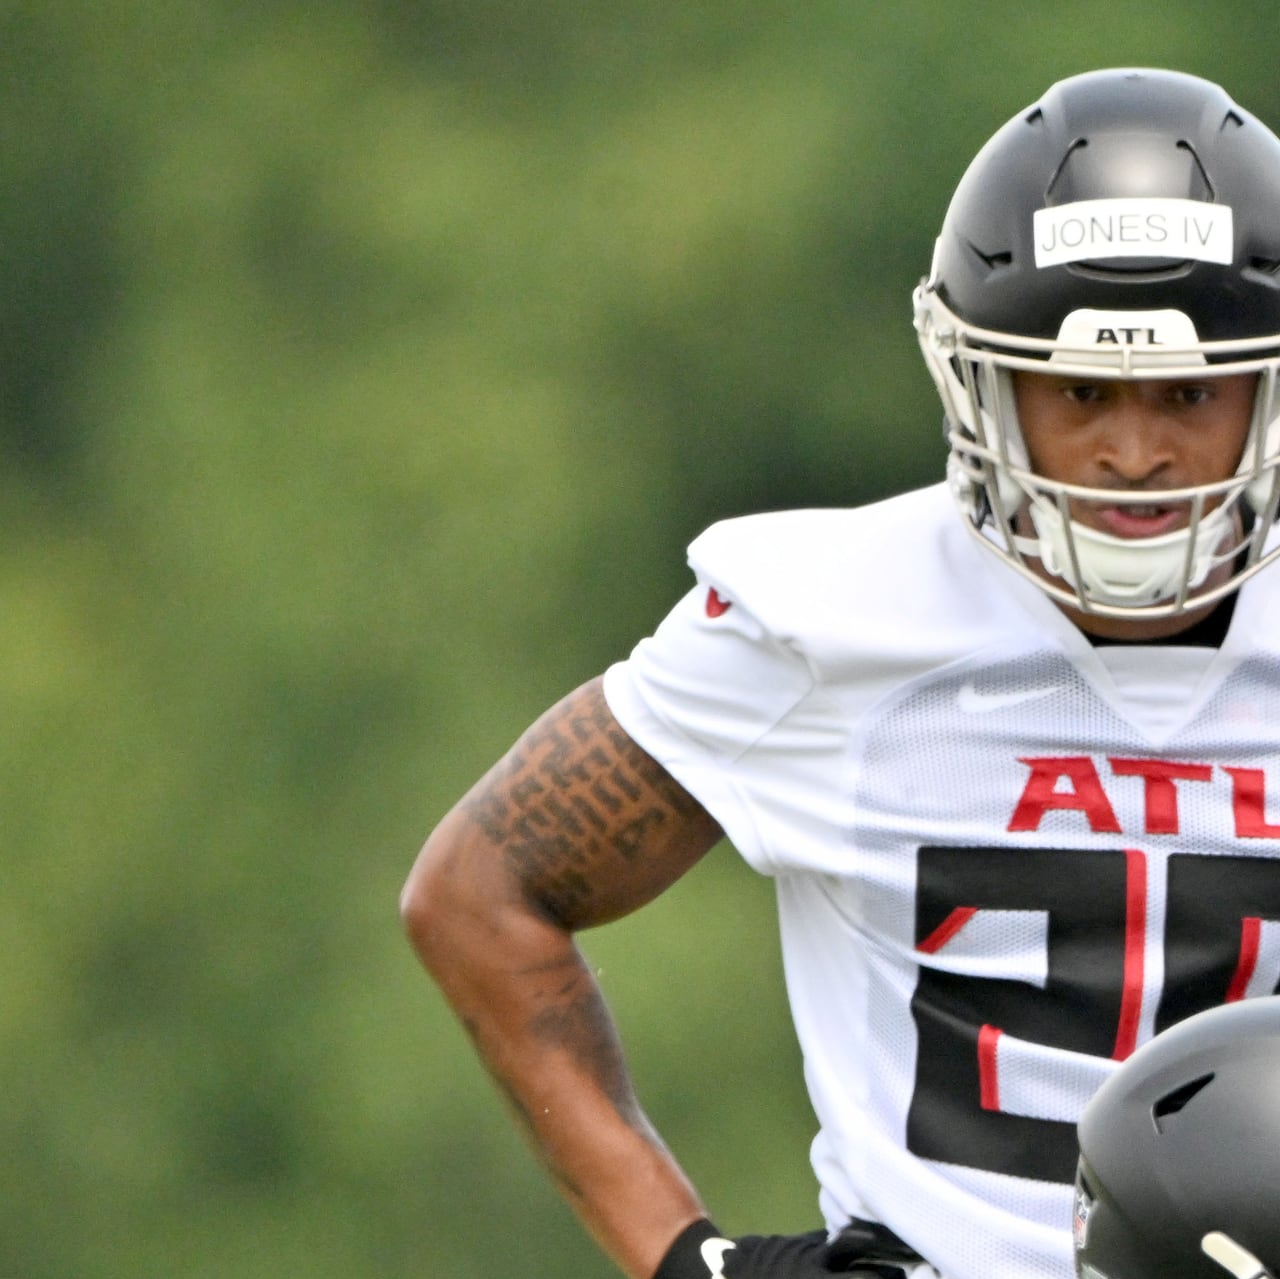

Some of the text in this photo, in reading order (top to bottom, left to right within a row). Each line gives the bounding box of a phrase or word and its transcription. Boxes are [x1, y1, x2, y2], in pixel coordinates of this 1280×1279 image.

[1041, 213, 1214, 253] JONES IV
[1094, 327, 1164, 345] ATL
